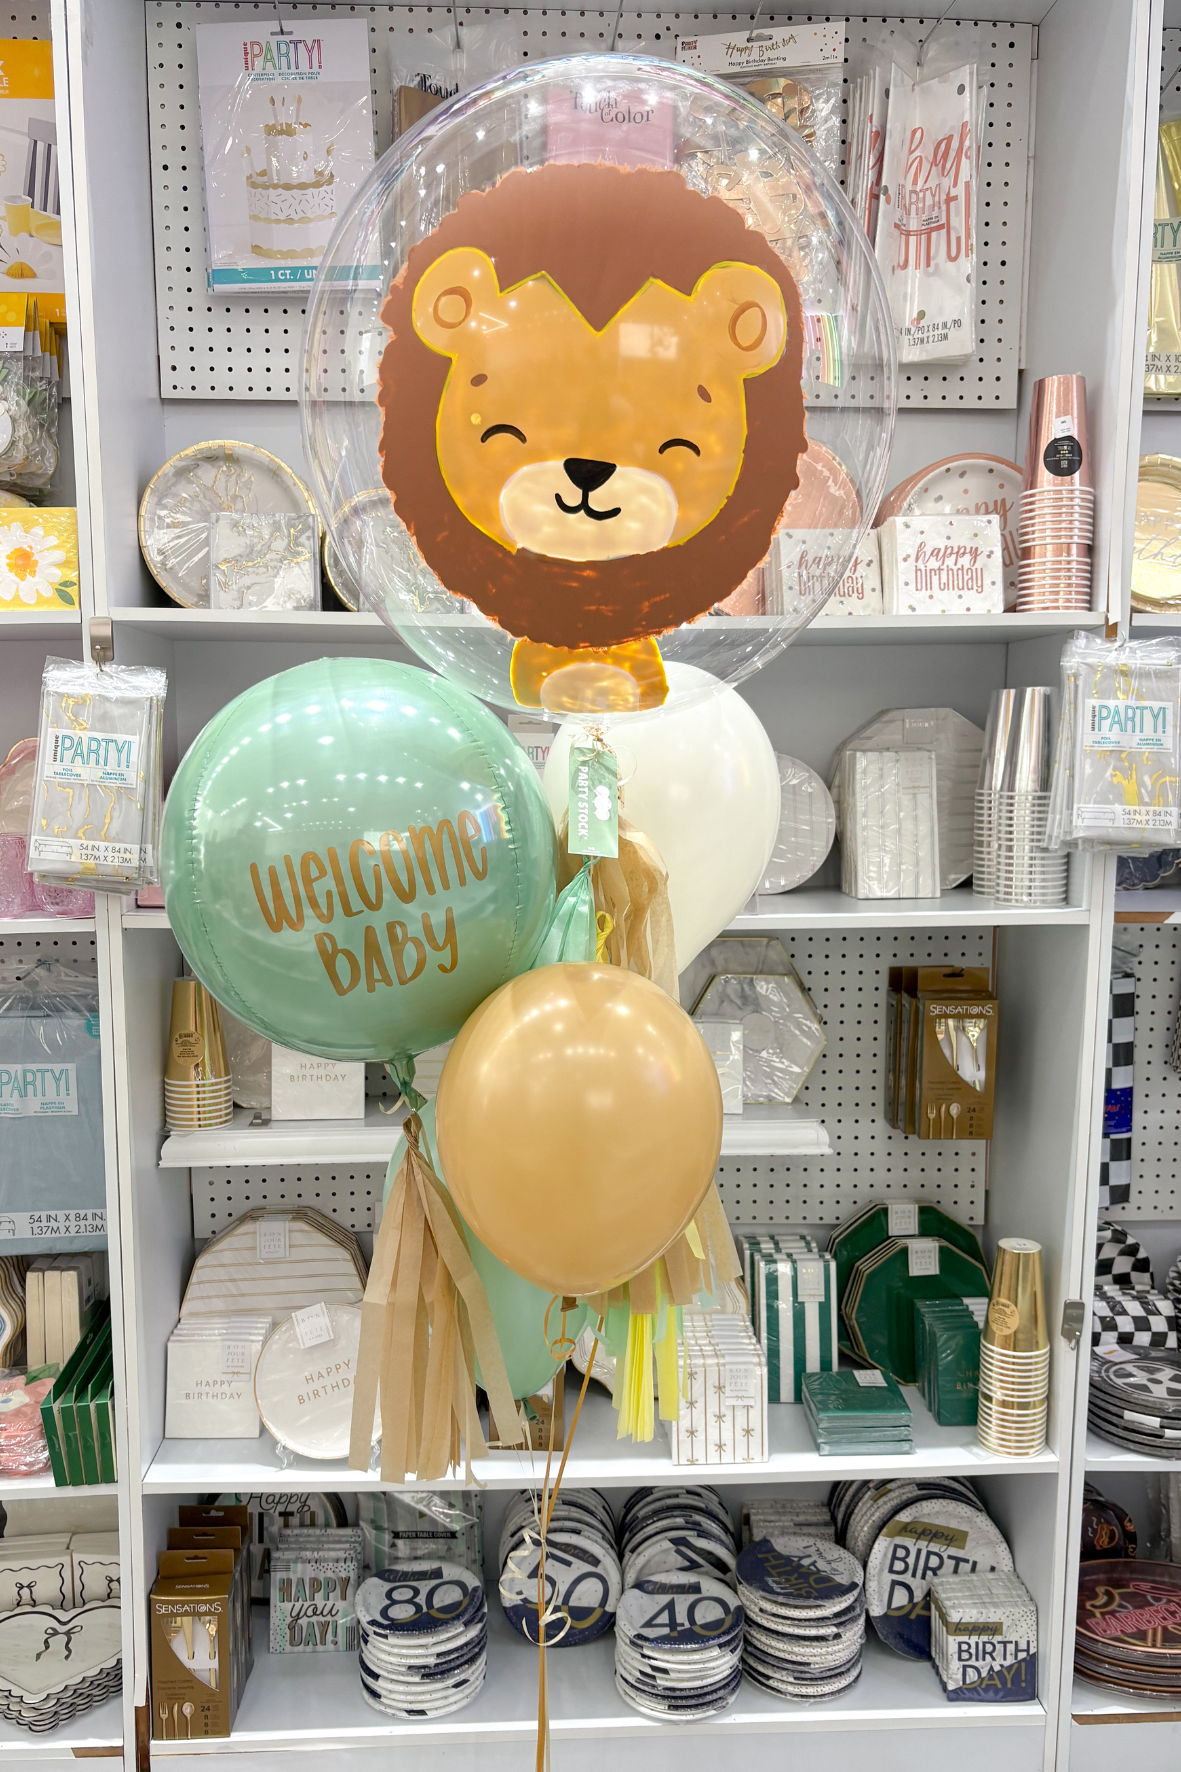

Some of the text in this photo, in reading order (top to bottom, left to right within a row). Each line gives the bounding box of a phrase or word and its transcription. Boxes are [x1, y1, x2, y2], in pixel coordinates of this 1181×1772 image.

[249, 39, 323, 71] PARTY!
[721, 40, 754, 58] Happy
[745, 57, 767, 65] Birthday
[570, 90, 618, 114] Touch
[600, 105, 654, 125] Color
[278, 269, 294, 279] CT.
[931, 322, 940, 333] 84
[1165, 354, 1172, 363] X
[1165, 364, 1172, 374] X
[799, 549, 864, 577] happy
[914, 540, 984, 567] happy
[799, 569, 865, 601] birthday
[914, 563, 985, 595] birthday
[1097, 704, 1167, 735] PARTY!
[59, 734, 132, 769] PARTY!
[577, 765, 589, 837] PARTY STOCK
[1121, 808, 1174, 818] 54 IN. X 84 IN.
[1122, 818, 1174, 827] 1.37M X 2.13M
[79, 843, 89, 852] 54
[90, 844, 102, 853] IN.
[103, 845, 110, 853] X
[111, 846, 121, 854] 84
[123, 847, 134, 856] IN.
[79, 853, 101, 862] 1.37M
[102, 855, 109, 863] X
[110, 855, 132, 865] 2.13M
[929, 1004, 995, 1016] SENSATIONS
[289, 1073, 347, 1083] BIRTHDAY
[300, 1062, 337, 1071] HAPPY
[0, 1068, 71, 1099] PARTY!
[28, 1211, 107, 1225] 54 IN. X 84 IN.
[30, 1223, 106, 1237] 1.37M X 2.13M
[304, 1358, 352, 1385] HAPPY
[195, 1380, 233, 1388] HAPPY
[184, 1392, 243, 1401] BIRTHDAY
[899, 1516, 959, 1553] happy
[278, 1576, 351, 1604] HAPPY
[380, 1579, 470, 1623] 80
[515, 1550, 610, 1629] 50
[155, 1602, 223, 1615] SENSATIONS
[287, 1602, 340, 1631] you
[639, 1595, 732, 1637] 40
[288, 1619, 339, 1648] DAY!
[953, 1616, 1000, 1641] happy
[956, 1639, 1031, 1664] BIRTH
[961, 1663, 1027, 1690] DAY!
[200, 1705, 211, 1713] 24
